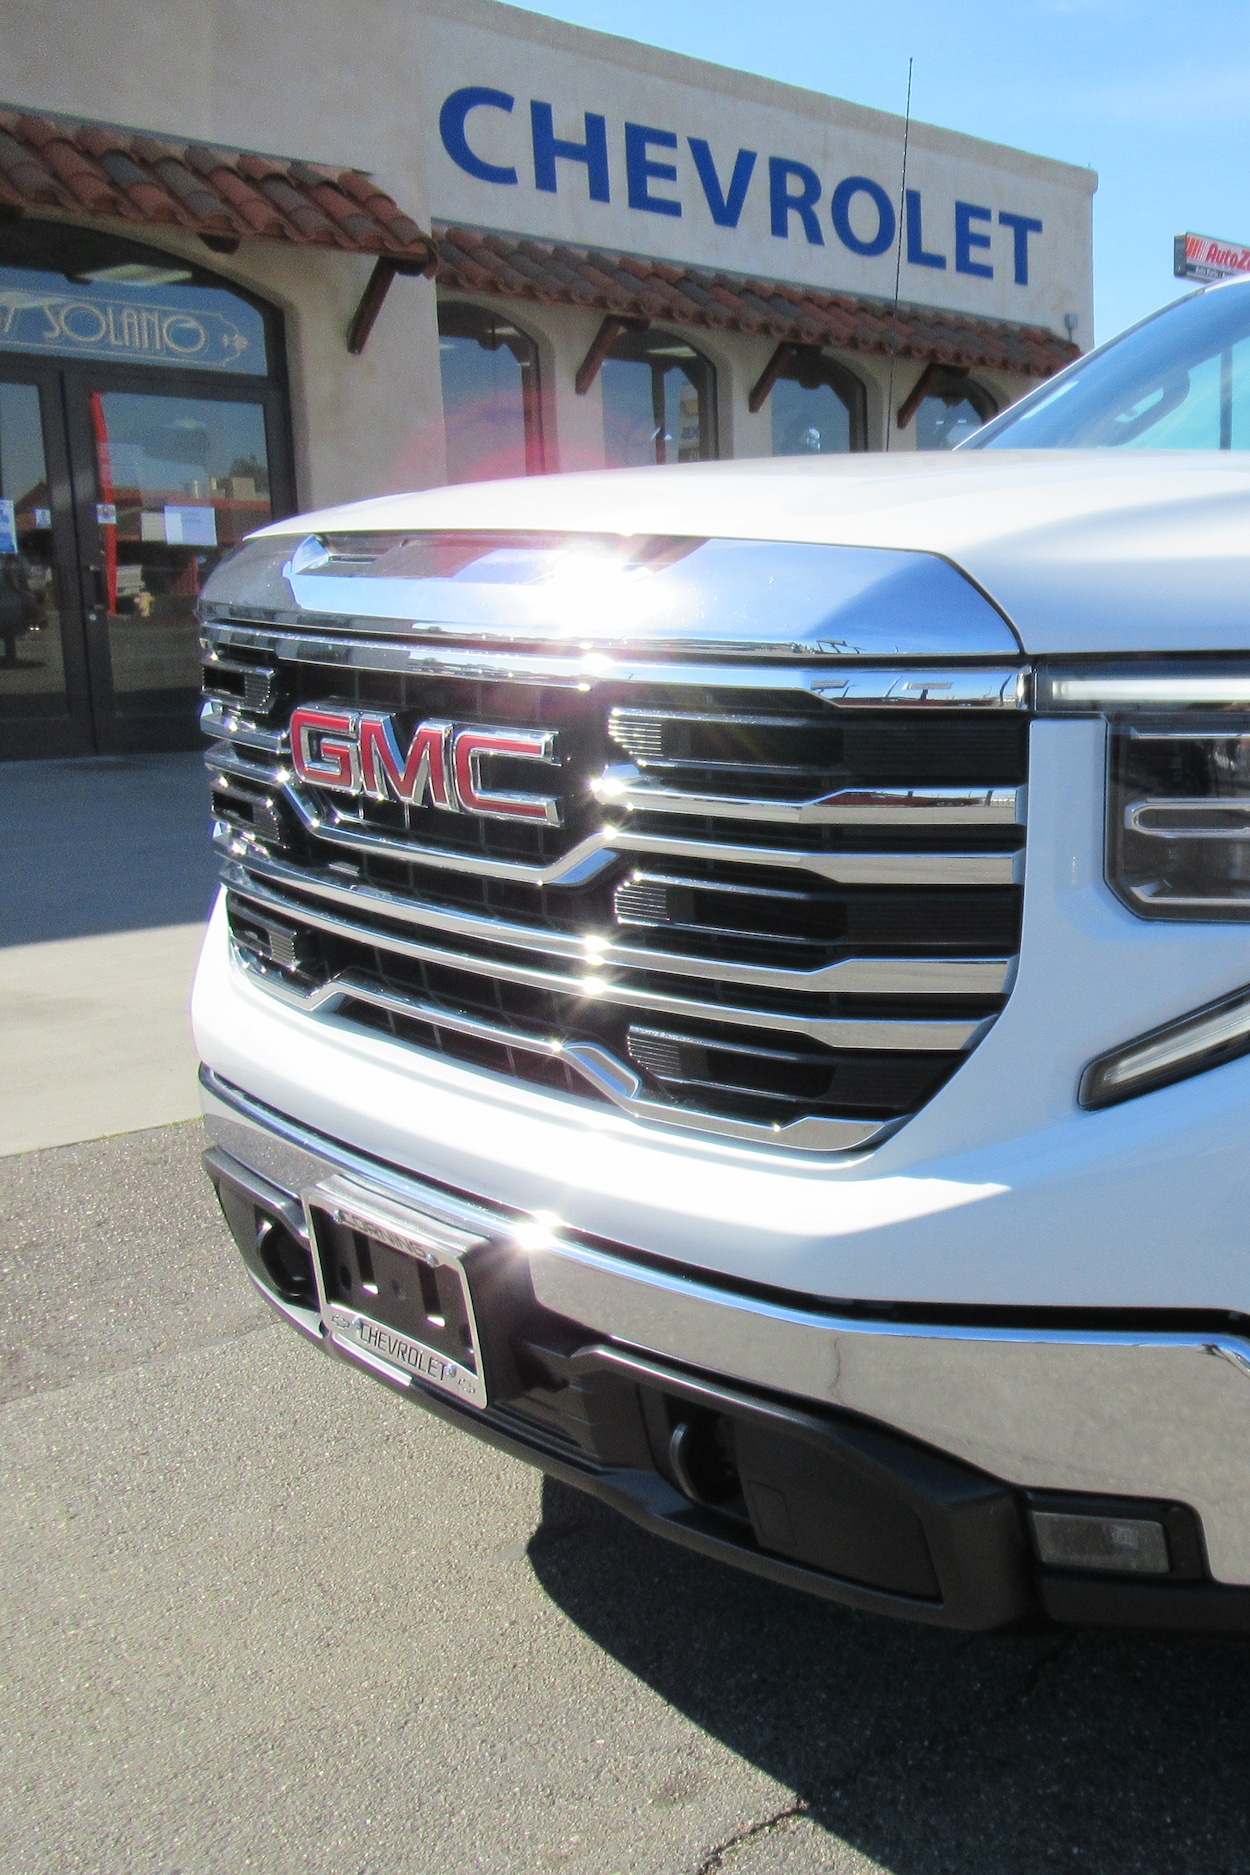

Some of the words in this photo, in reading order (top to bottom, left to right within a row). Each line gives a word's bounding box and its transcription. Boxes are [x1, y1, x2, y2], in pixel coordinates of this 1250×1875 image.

[438, 86, 1043, 286] CHEVROLET
[43, 301, 206, 353] SOLANO
[289, 702, 563, 827] GMC
[360, 1322, 447, 1382] CHEVROLET
